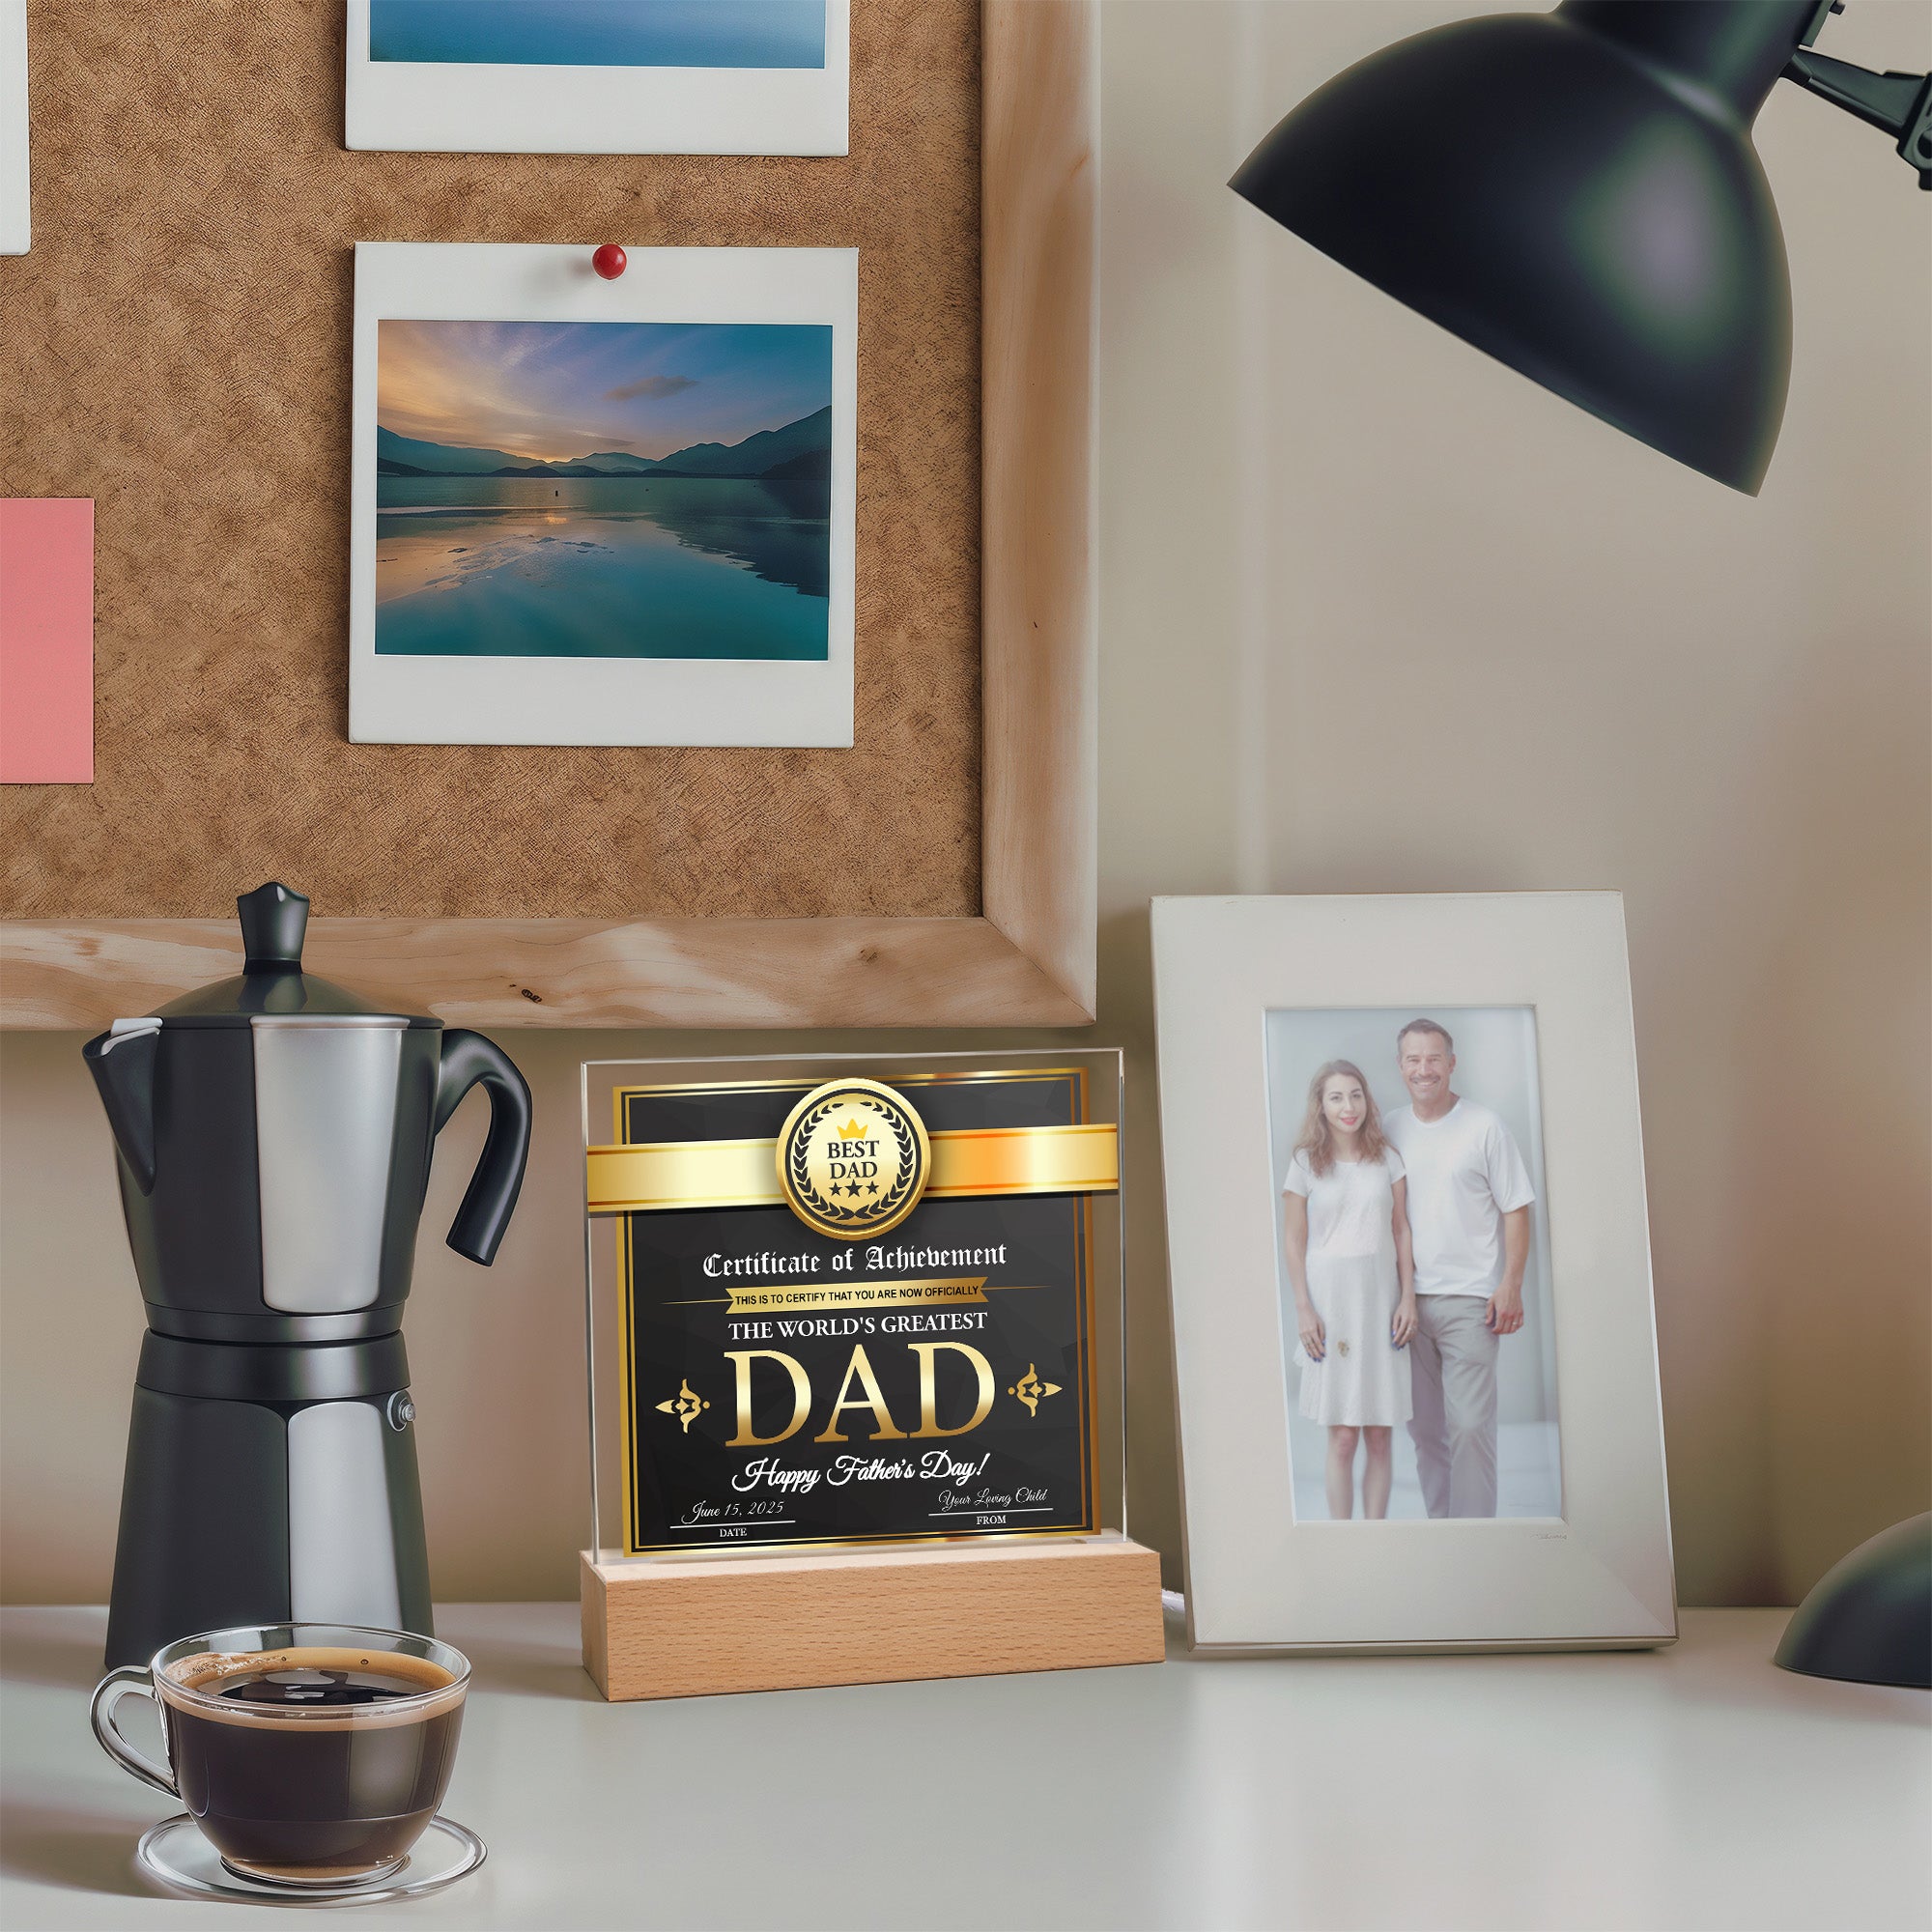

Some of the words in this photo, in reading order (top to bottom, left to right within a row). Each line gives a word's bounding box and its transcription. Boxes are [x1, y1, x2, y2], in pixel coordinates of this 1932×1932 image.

[827, 1140, 880, 1159] BEST
[830, 1161, 878, 1179] DAD
[703, 1252, 821, 1278] Certificate
[832, 1248, 853, 1272] of
[866, 1243, 1008, 1273] Achievement
[735, 1295, 757, 1305] THIS
[758, 1294, 769, 1304] IS
[770, 1293, 783, 1304] TO
[785, 1292, 826, 1303] CERTIFY
[828, 1291, 853, 1301] THAT
[854, 1290, 874, 1300] YOU
[877, 1289, 898, 1299] ARE
[899, 1288, 923, 1298] NOW
[924, 1286, 979, 1297] OFFICIALLY
[728, 1321, 774, 1341] THE
[777, 1317, 875, 1338] WORLD'S
[881, 1311, 988, 1334] GREATEST
[724, 1342, 996, 1447] DAD
[731, 1457, 822, 1493] Happy
[920, 1450, 991, 1486] Day!
[938, 1490, 971, 1512] Your
[974, 1488, 1012, 1508] Loving
[1015, 1487, 1048, 1503] Child
[681, 1500, 721, 1524] June
[724, 1503, 742, 1518] 15,
[748, 1500, 784, 1516] 2025
[976, 1515, 1007, 1525] FROM
[720, 1527, 748, 1537] DATE
